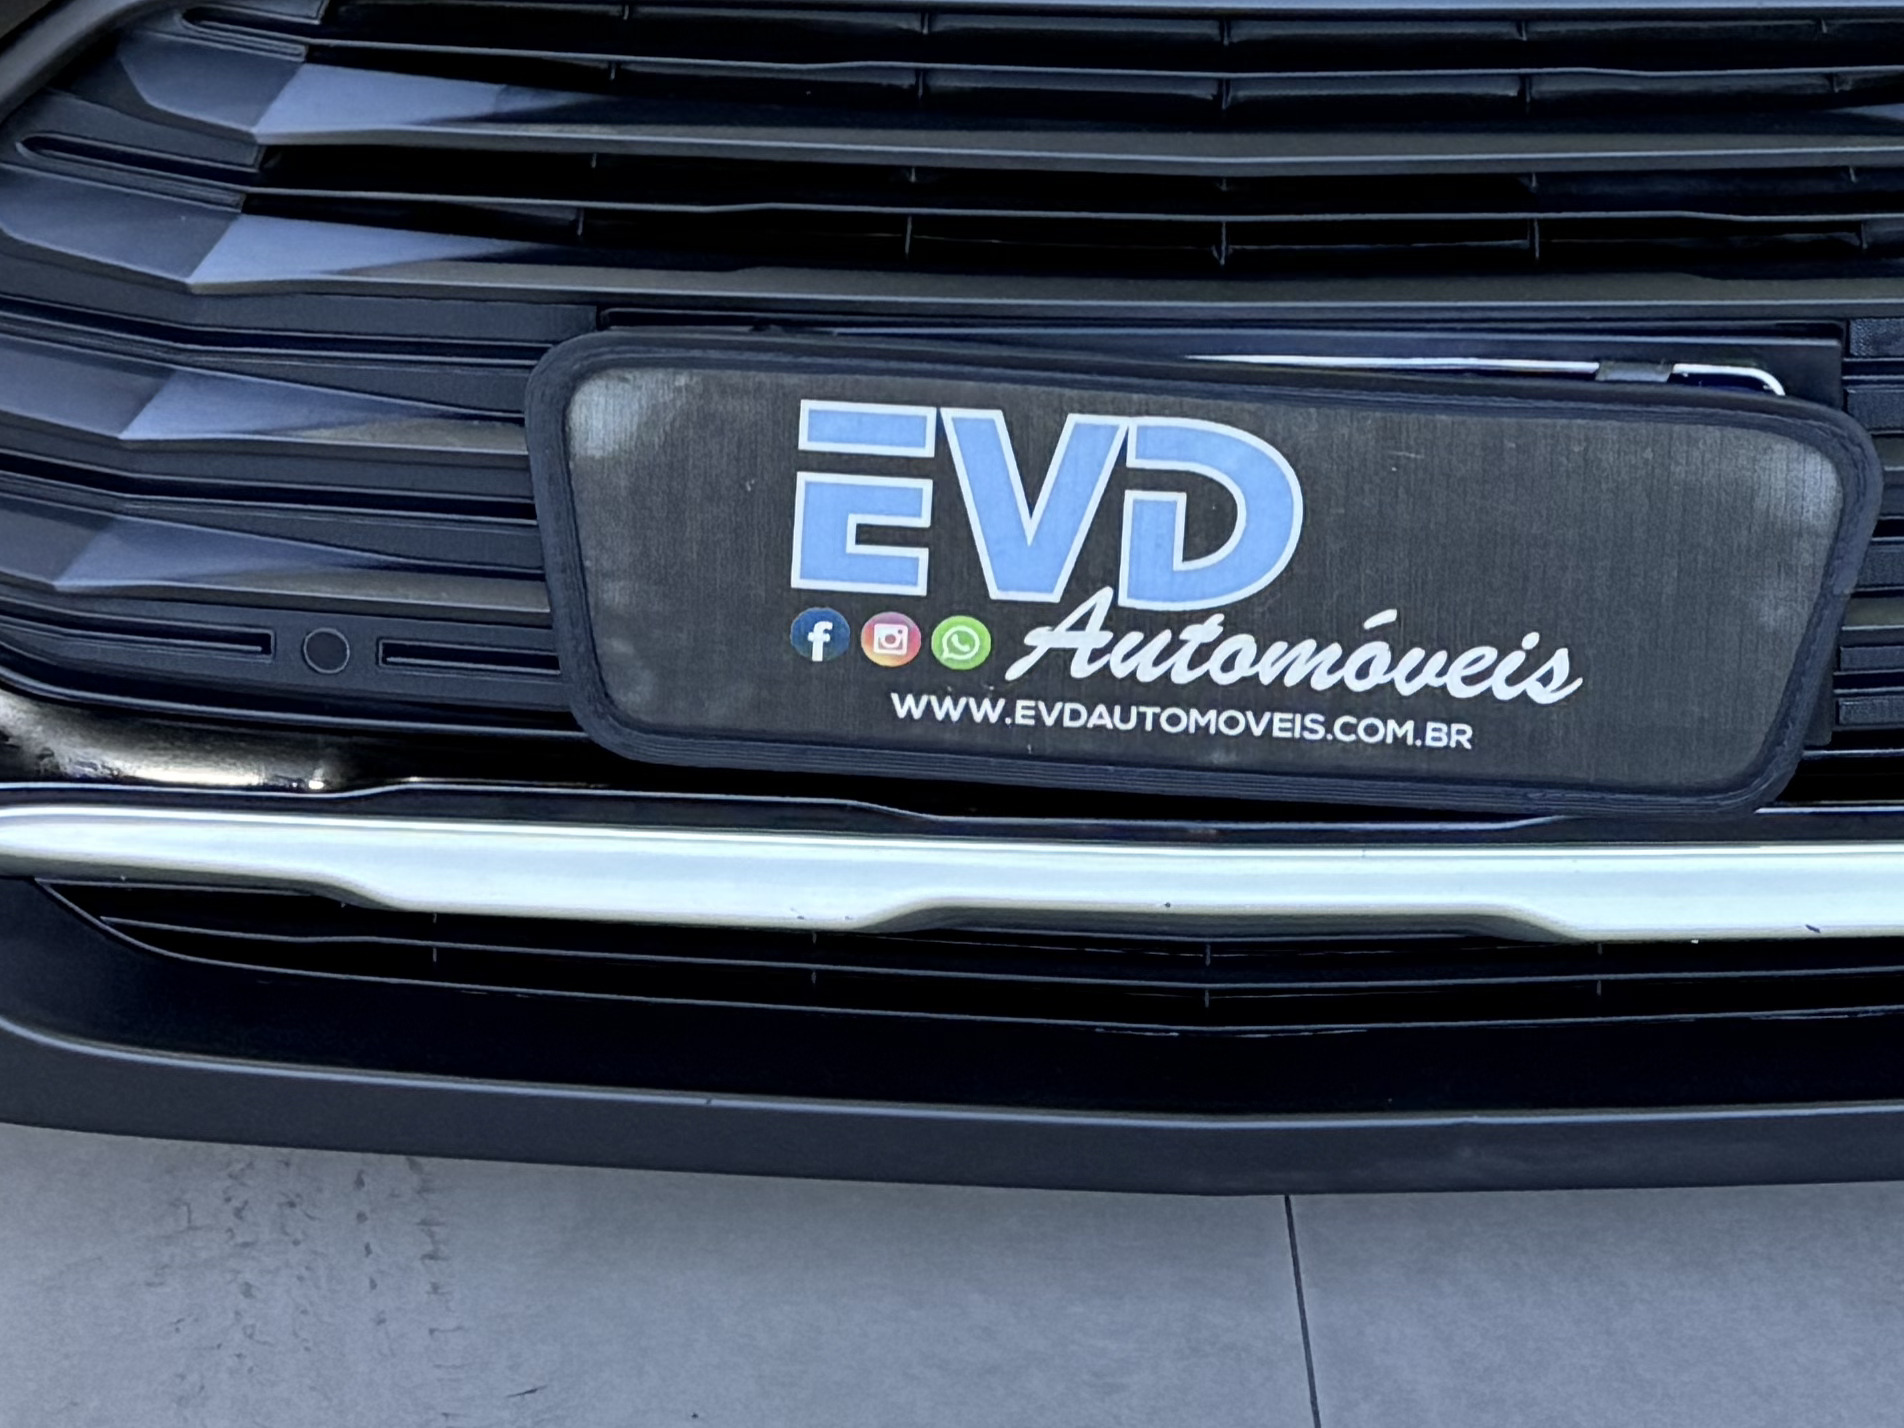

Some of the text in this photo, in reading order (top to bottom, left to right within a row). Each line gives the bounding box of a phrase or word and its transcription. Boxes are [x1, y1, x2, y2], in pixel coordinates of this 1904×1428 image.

[790, 399, 1304, 612] EVD
[1004, 586, 1584, 705] Automóveis
[890, 692, 1474, 750] WWW.EVDAUTOMOVEIS.COM.BR
